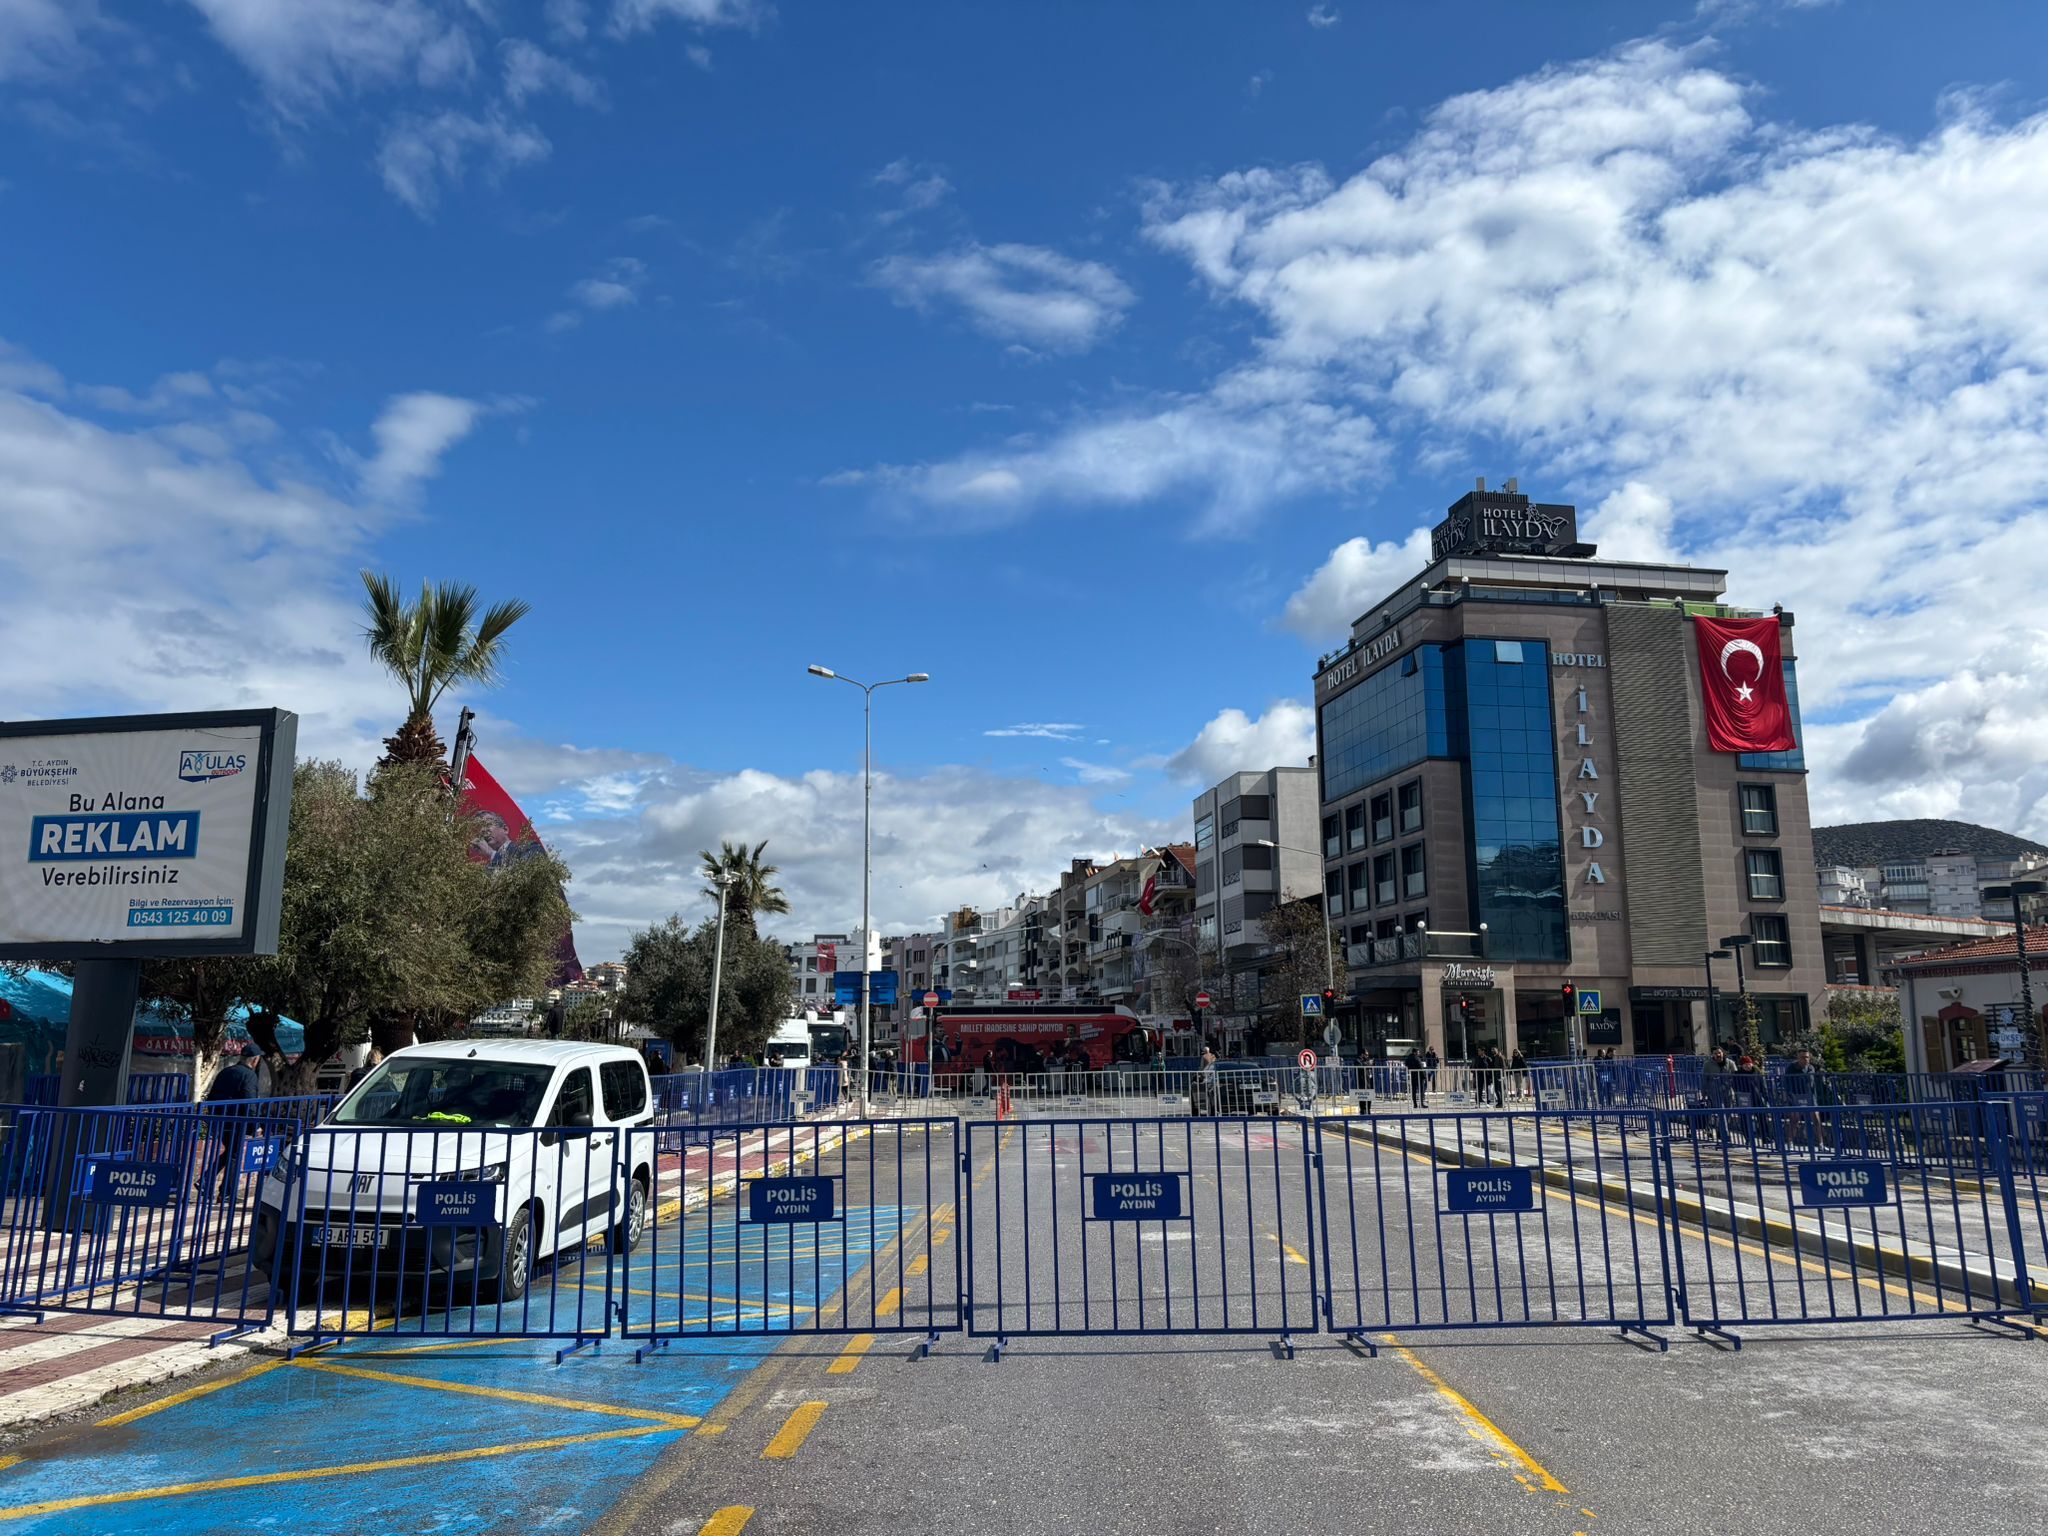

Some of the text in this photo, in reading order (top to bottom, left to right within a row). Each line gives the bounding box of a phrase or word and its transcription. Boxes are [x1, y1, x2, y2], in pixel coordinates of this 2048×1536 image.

[1483, 507, 1523, 520] HOTEL
[1327, 630, 1399, 690] HOTEL İLAYDA
[1552, 652, 1607, 668] HOTEL
[46, 759, 69, 767] AYDIN
[20, 766, 78, 778] BÜYÜKŞEHİR
[27, 778, 69, 786] BELEDİYESİ
[1577, 684, 1606, 885] İLAYDA
[69, 791, 165, 812] Bu Alana
[40, 819, 188, 854] REKLAM
[42, 865, 179, 886] Verebilirsiniz
[129, 898, 148, 908] Bilgi
[161, 897, 214, 908] Rezervasyon
[216, 895, 234, 907] İçin:
[134, 911, 227, 924] 0543 125 40 09
[1017, 1023, 1037, 1033] SAHİP
[109, 1170, 156, 1185] POLİS
[1816, 1168, 1870, 1185] POLİS
[1111, 1180, 1163, 1197] POLİS
[1467, 1178, 1512, 1193] POLİS
[114, 1187, 148, 1198] AYDIN
[435, 1191, 476, 1205] POLİS
[766, 1185, 817, 1203] POLİS
[1476, 1195, 1506, 1203] AYDIN
[1827, 1188, 1864, 1198] AYDIN
[775, 1204, 810, 1215] AYDIN
[1120, 1199, 1156, 1209] AYDIN
[440, 1207, 470, 1215] AYDIN
